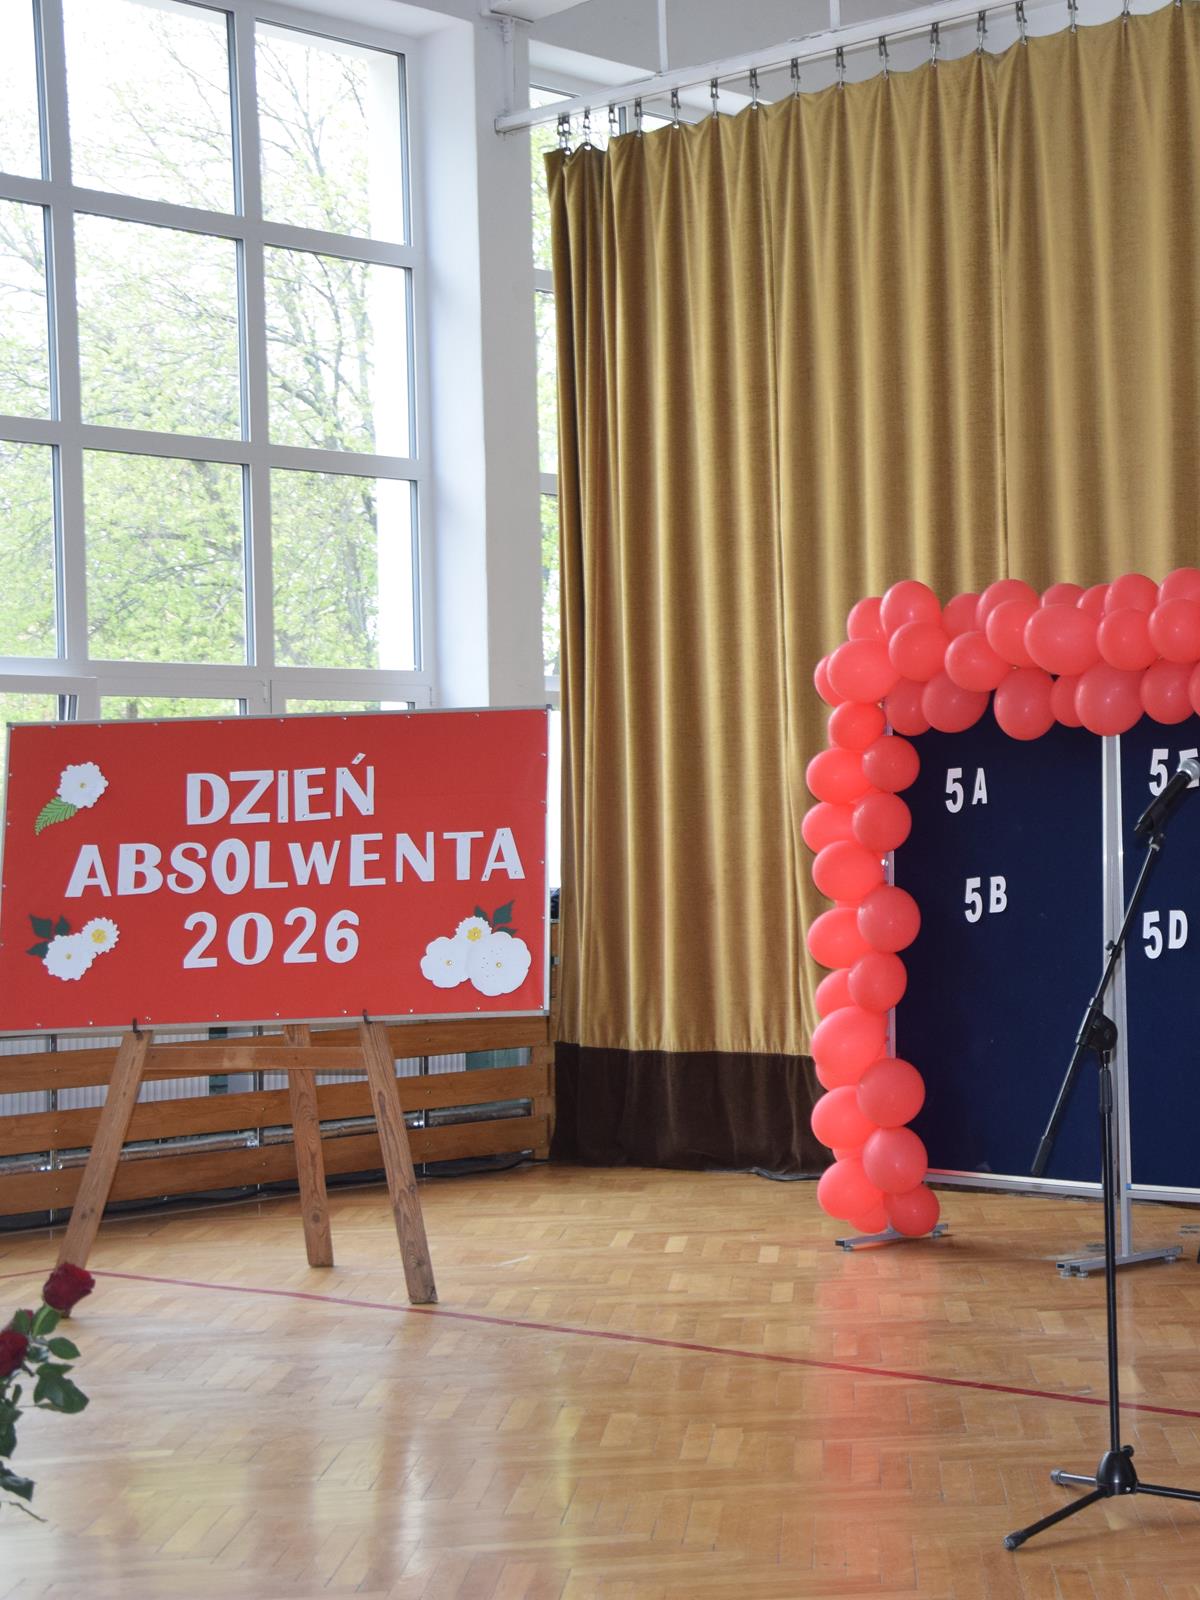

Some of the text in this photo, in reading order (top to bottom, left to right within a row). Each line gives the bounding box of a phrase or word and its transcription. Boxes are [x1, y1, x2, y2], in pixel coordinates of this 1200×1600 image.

[187, 753, 375, 826] DZIEŃ
[64, 827, 526, 898] ABSOLWENTA
[183, 906, 360, 969] 2026
